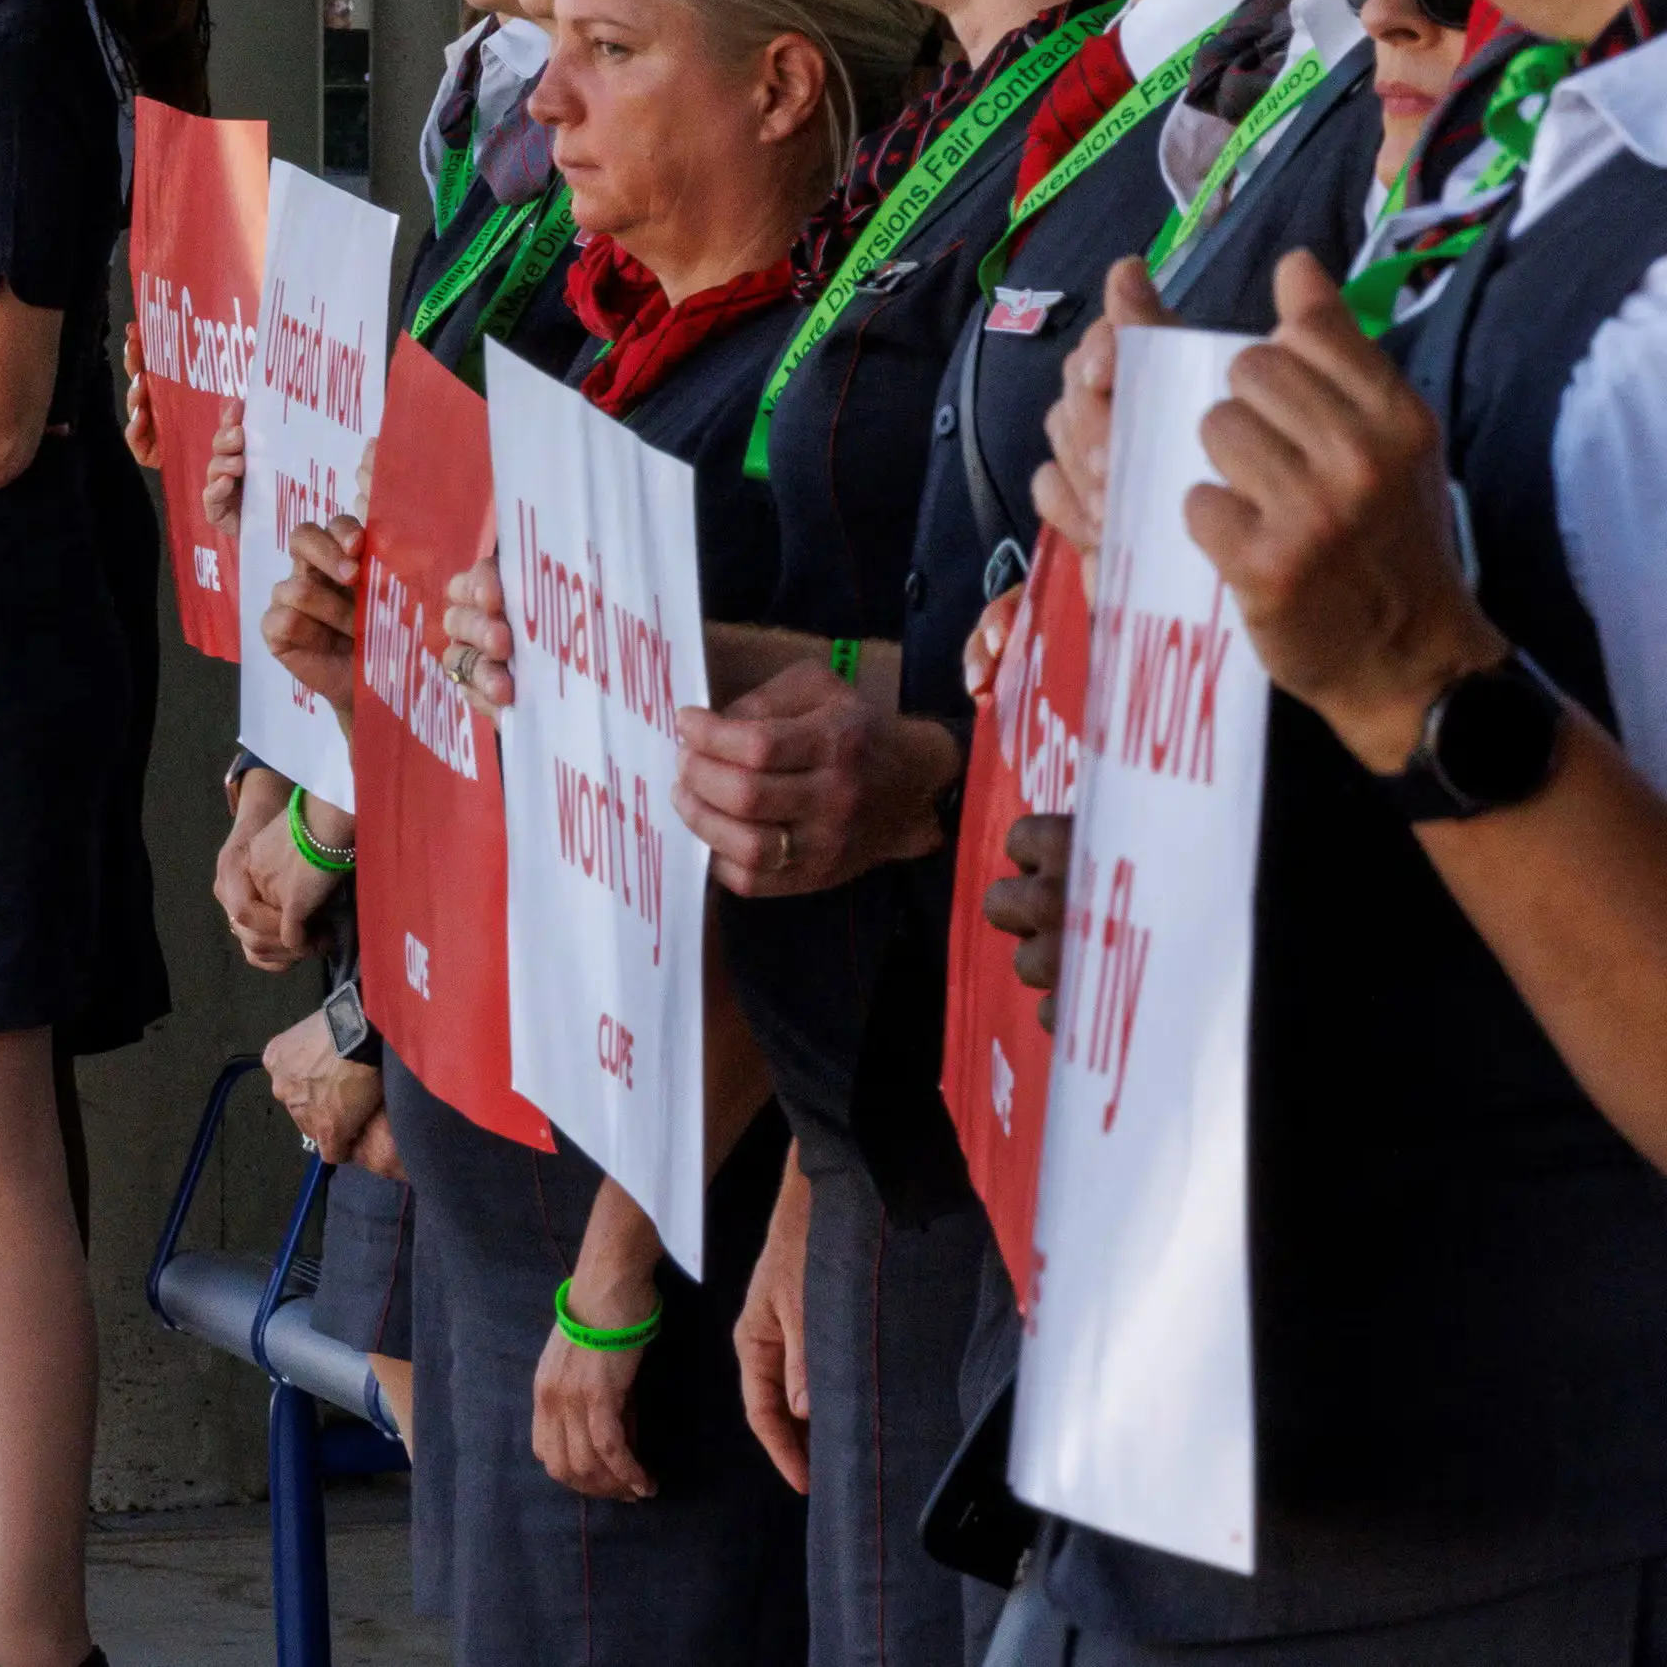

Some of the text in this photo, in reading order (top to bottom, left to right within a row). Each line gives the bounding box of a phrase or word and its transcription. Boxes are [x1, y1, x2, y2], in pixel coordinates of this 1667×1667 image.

[1138, 56, 1195, 106] Fair
[783, 314, 827, 378] More
[971, 31, 1083, 133] Contract
[139, 270, 181, 384] UnfAir
[265, 277, 366, 436] Unpaid work
[193, 544, 221, 593] CUPE
[517, 497, 680, 743] Unpaid work
[1020, 632, 1080, 816] Cana
[1123, 569, 1232, 786] work
[554, 754, 662, 967] won't fly
[404, 931, 431, 1001] CUPE
[597, 1011, 634, 1092] CUPE
[1089, 858, 1150, 1136] fly
